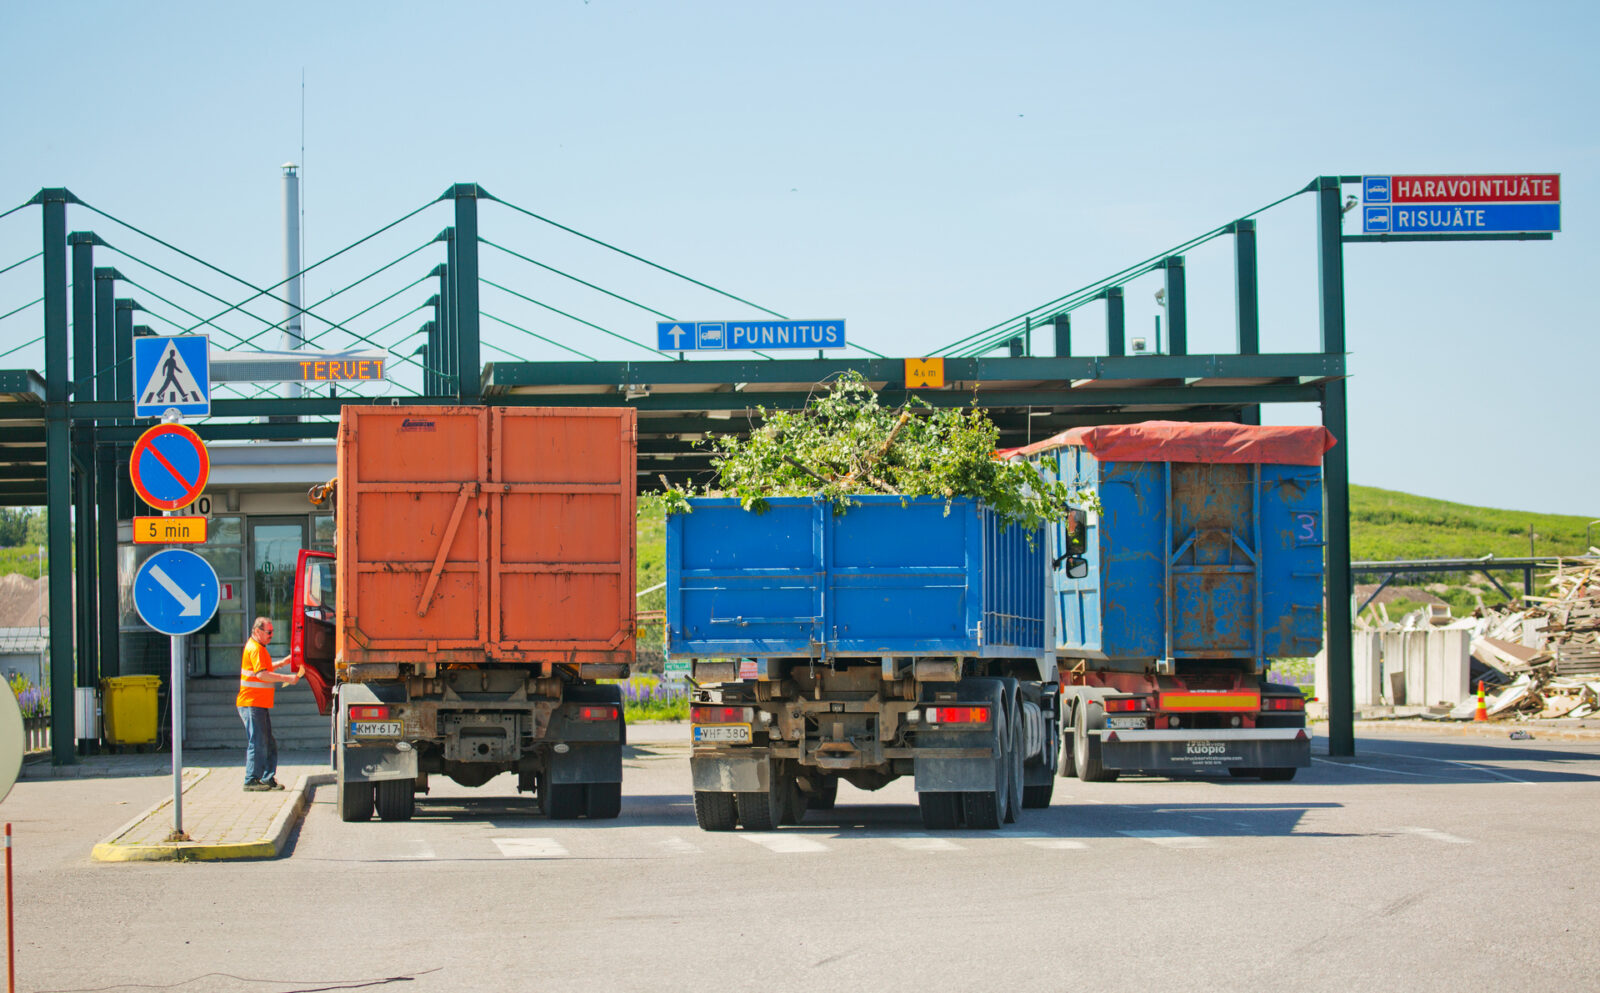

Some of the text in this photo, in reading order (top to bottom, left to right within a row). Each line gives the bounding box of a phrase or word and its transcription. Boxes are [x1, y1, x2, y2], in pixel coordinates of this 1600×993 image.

[1397, 177, 1552, 198] HARAVOINTIJÄTE
[1398, 207, 1485, 227] RISUJÄTE
[733, 325, 837, 344] PUNNITUS
[299, 360, 383, 380] TERVET
[149, 522, 190, 538] 5 min
[358, 724, 398, 734] KMY-617
[1187, 743, 1225, 755] Kuopio
